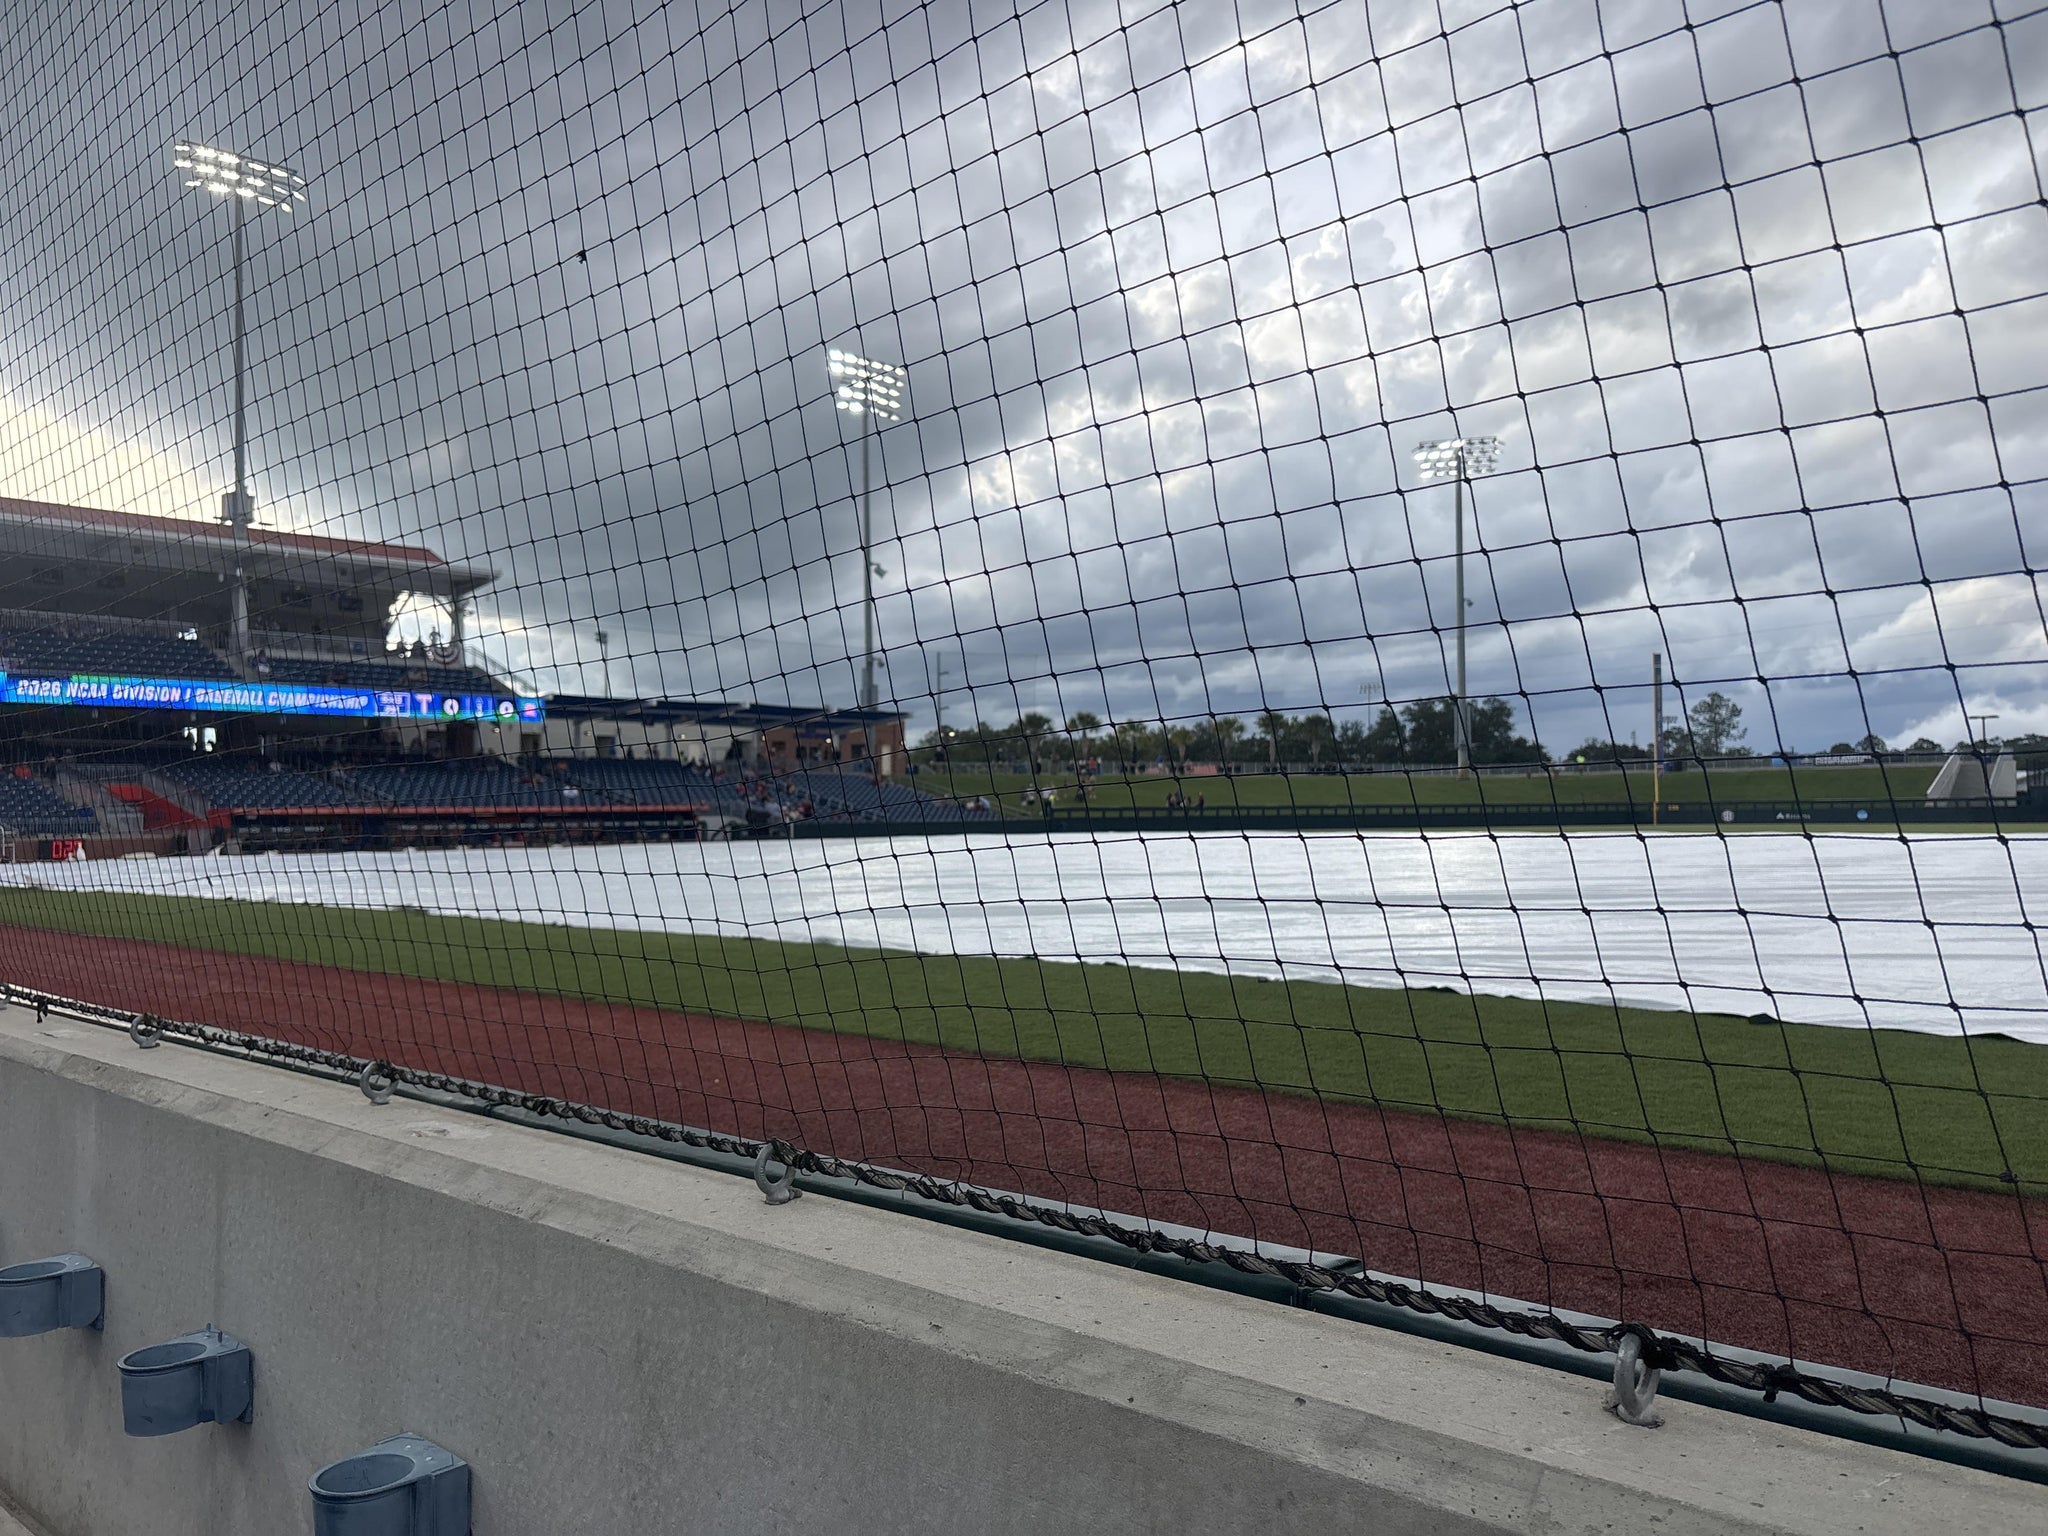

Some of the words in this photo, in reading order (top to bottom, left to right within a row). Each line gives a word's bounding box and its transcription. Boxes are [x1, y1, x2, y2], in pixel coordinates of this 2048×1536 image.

[66, 682, 108, 699] NCAA
[112, 684, 182, 703] DIVISION
[195, 687, 264, 705] BASEBALL
[267, 691, 368, 710] CHAMPIONSHIP
